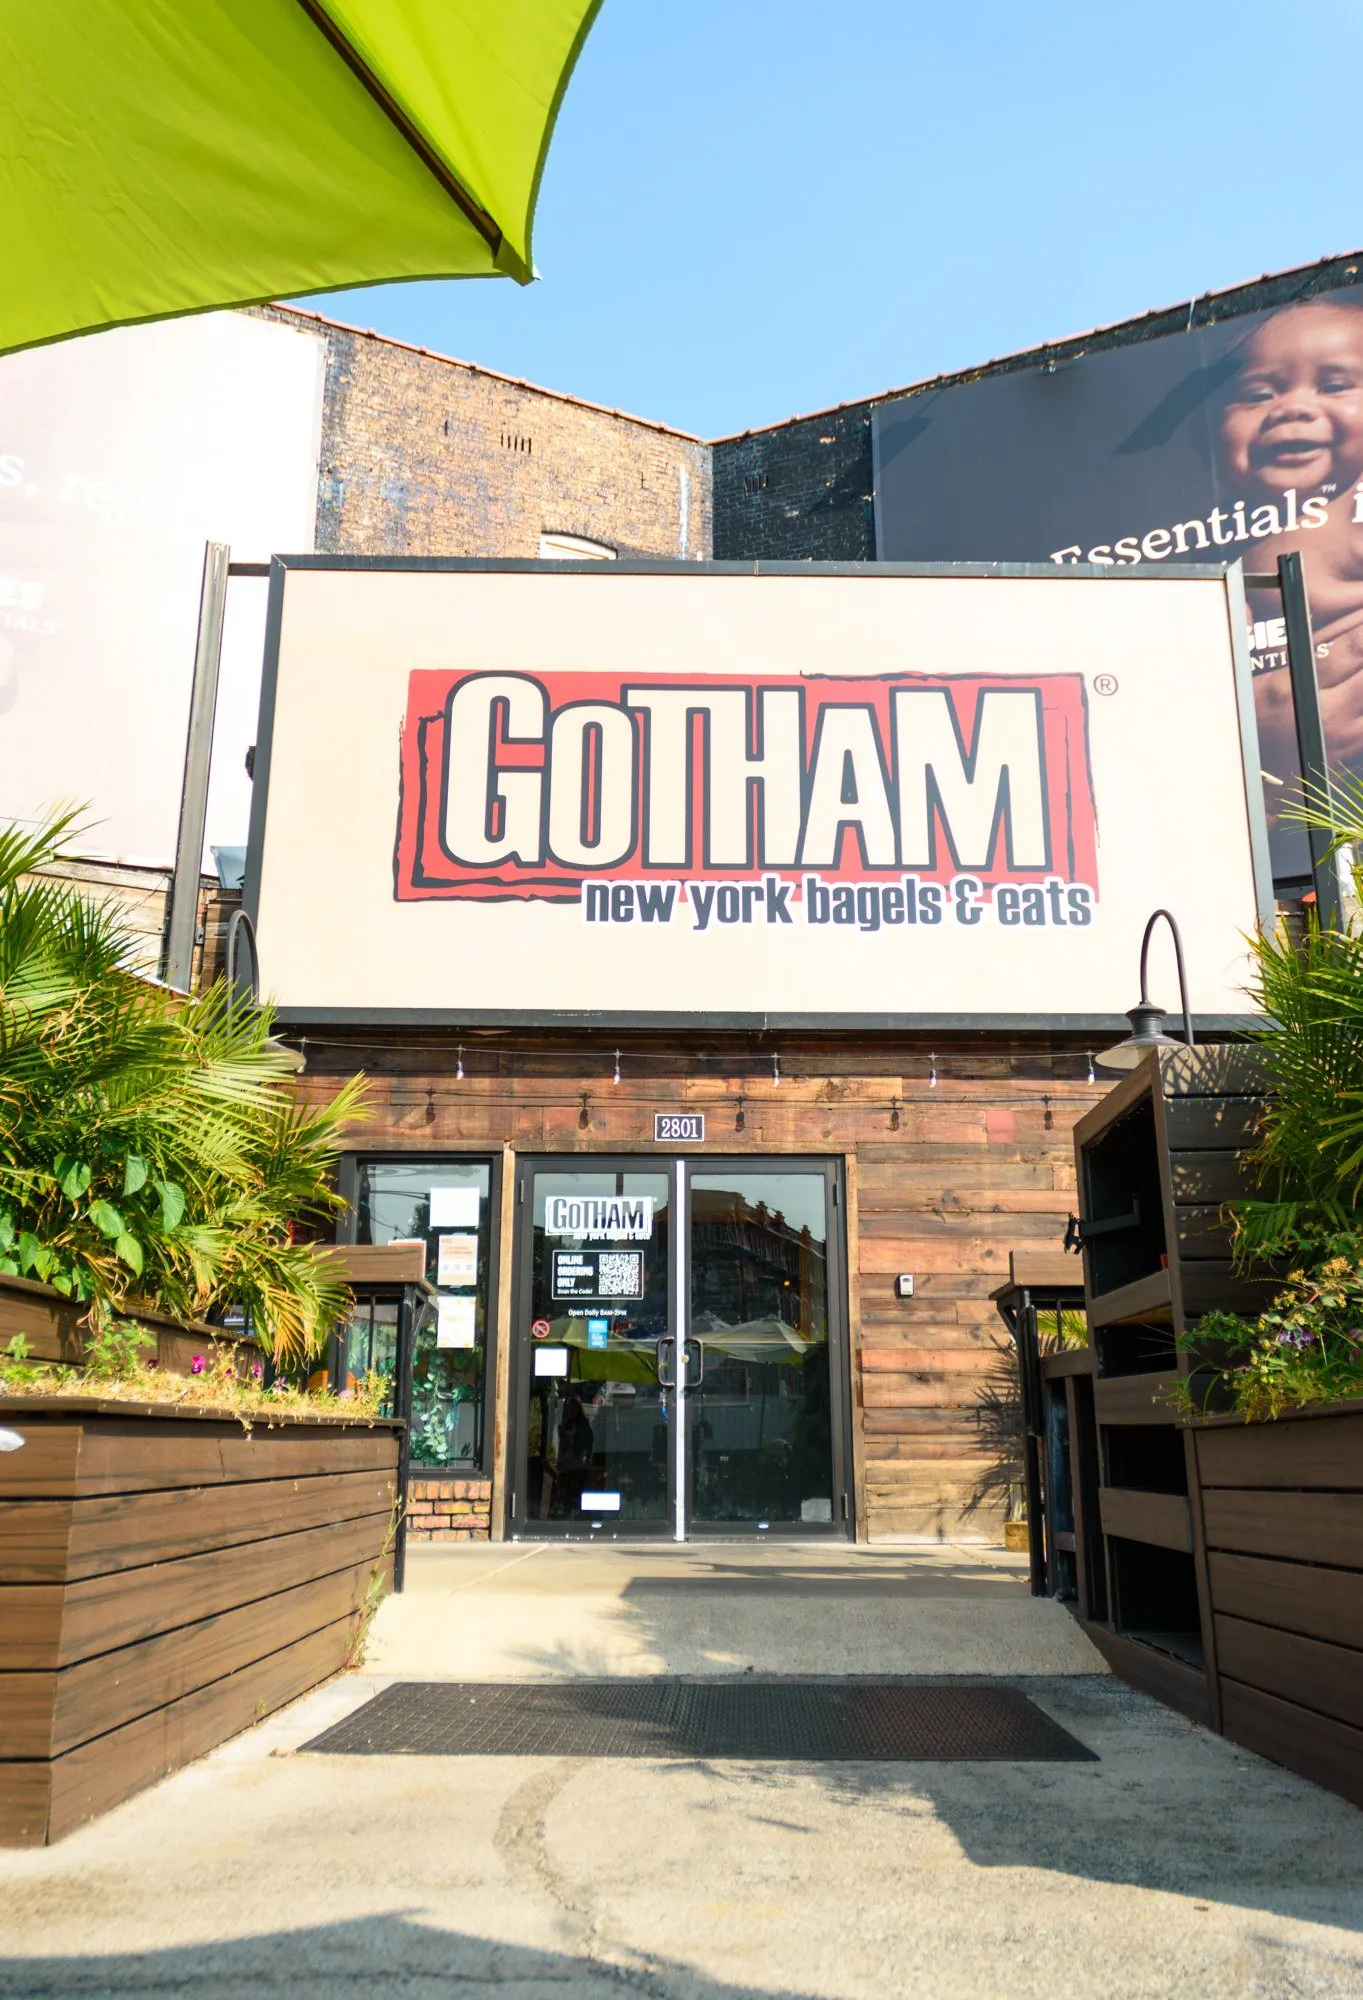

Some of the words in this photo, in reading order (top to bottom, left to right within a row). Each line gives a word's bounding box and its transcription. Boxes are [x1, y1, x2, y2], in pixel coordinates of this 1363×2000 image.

[438, 669, 1053, 873] GOTHAM
[584, 882, 677, 924] new
[689, 876, 794, 931] york
[806, 876, 943, 932] bagels
[955, 878, 984, 926] &
[1000, 879, 1093, 926] eats
[660, 1117, 699, 1138] 2801
[552, 1198, 644, 1230] GOTHAM
[557, 1254, 584, 1266] ONLINE
[557, 1266, 594, 1277] ORDERING
[556, 1277, 576, 1288] ONLY
[568, 1308, 584, 1317] Open
[584, 1308, 600, 1317] Daily
